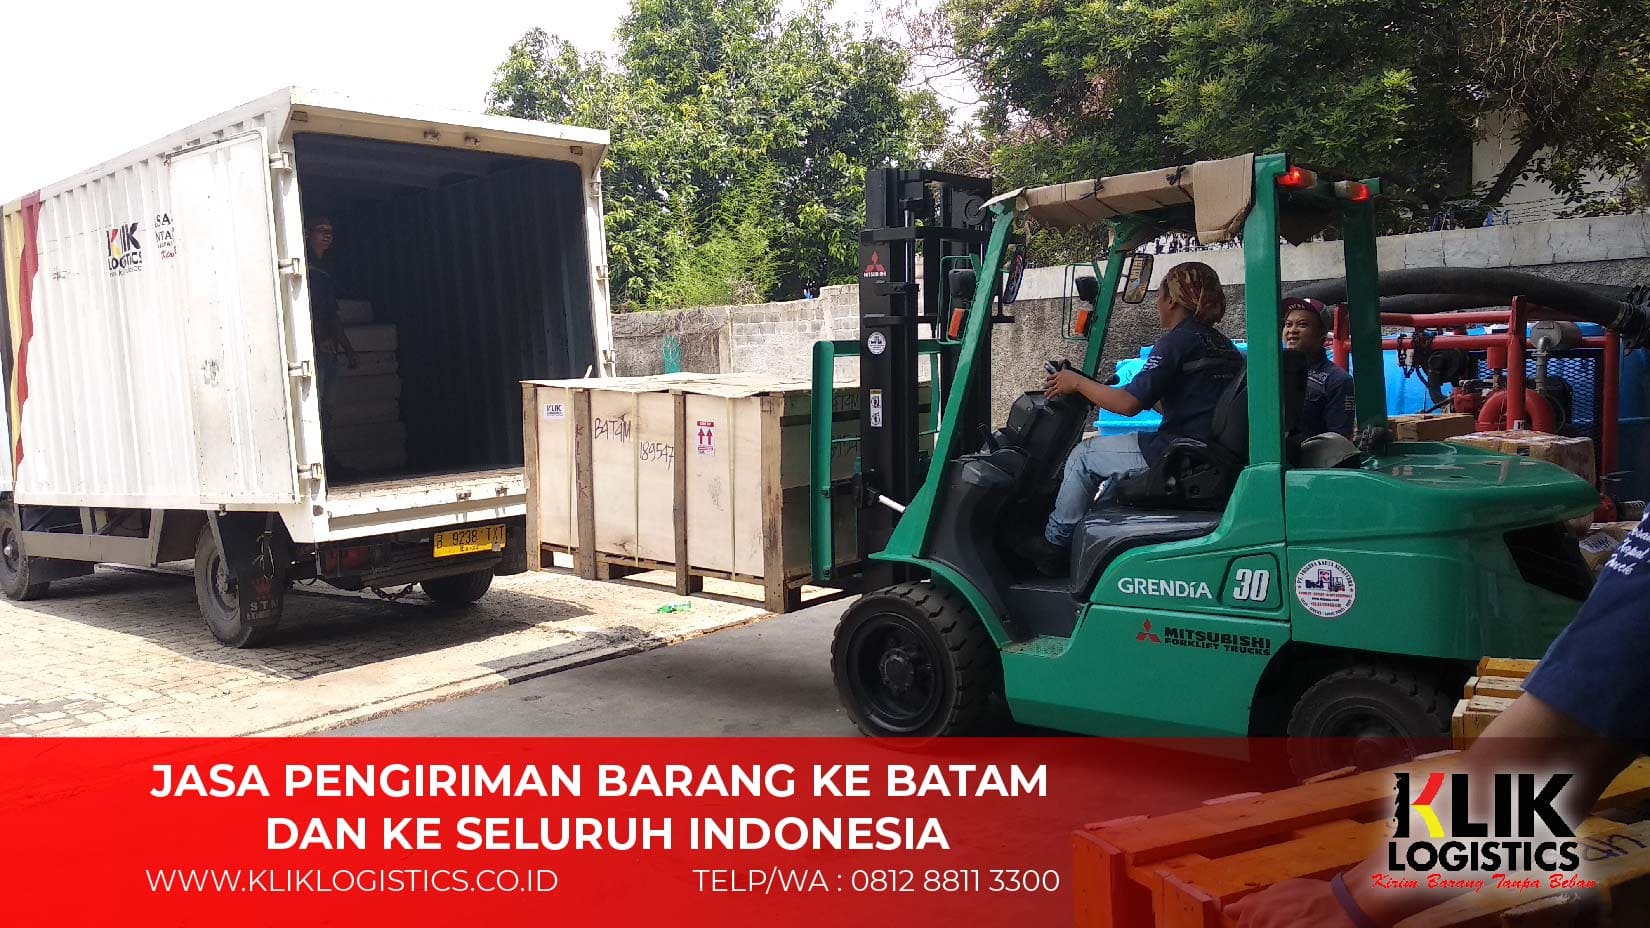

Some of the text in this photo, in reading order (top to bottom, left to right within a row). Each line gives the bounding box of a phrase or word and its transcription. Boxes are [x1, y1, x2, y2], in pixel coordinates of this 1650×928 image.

[594, 417, 632, 444] BATAM
[436, 534, 443, 549] B
[452, 529, 478, 546] 9238
[486, 525, 505, 541] TXT
[1232, 567, 1271, 602] 30
[1164, 626, 1271, 649] MITSUBISHI
[1164, 637, 1271, 656] FORKLIFT TRUCKS
